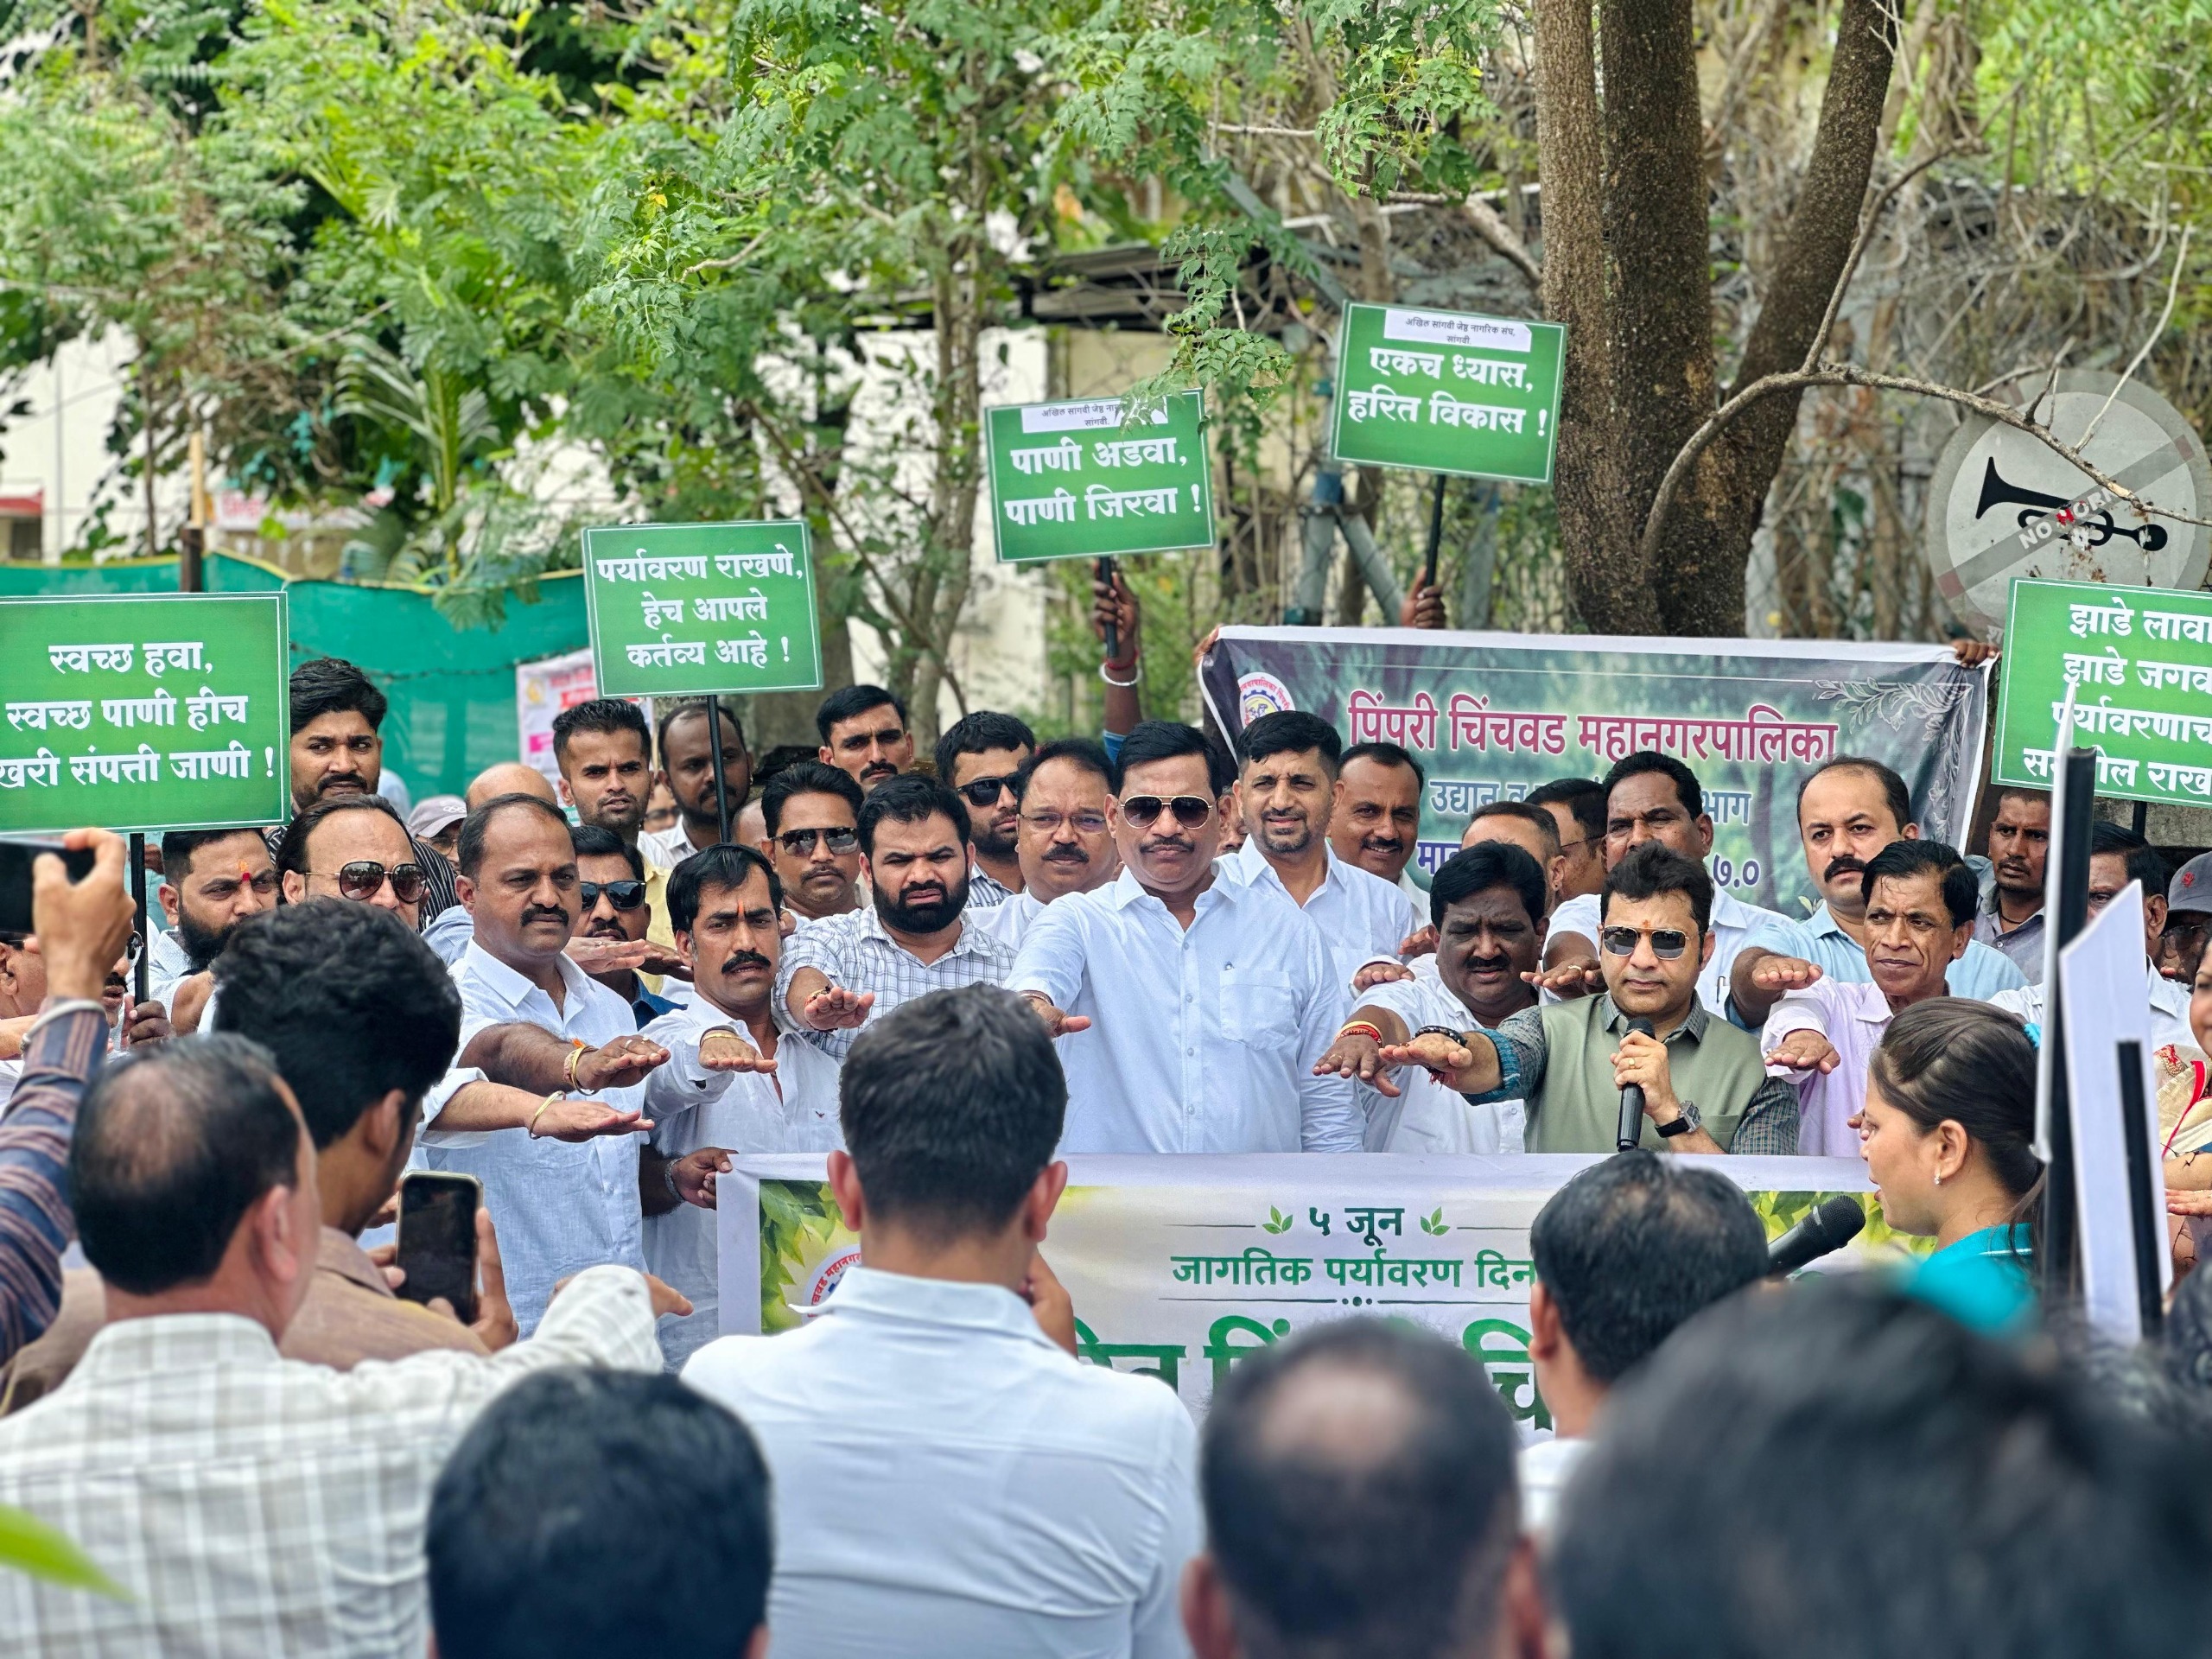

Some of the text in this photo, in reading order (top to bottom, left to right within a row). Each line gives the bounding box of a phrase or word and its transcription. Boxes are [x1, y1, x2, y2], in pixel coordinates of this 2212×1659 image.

[1370, 347, 1533, 393] एकच ध्यास,
[1348, 384, 1421, 423] हरित
[1429, 391, 1526, 434] विकास
[1010, 436, 1187, 474] पाणी अडवा,
[1004, 487, 1077, 525] पाणी
[1084, 484, 1178, 520] जिरवा
[2018, 521, 2052, 550] NO
[596, 543, 803, 583] पर्यावरण राखणे,
[641, 588, 768, 630] हेच आपले
[2070, 597, 2134, 638] झाडे
[48, 642, 213, 677] स्वच्छ हवा,
[626, 634, 706, 668] कर्तव्य
[715, 630, 767, 669] आहे
[2063, 646, 2212, 695] झाडे जगव
[5, 686, 248, 732] स्वच्छ पाणी हीच
[1348, 690, 1839, 764] पिंपरी चिंचवड महानगरपालिका
[0, 747, 60, 788] खरी
[69, 743, 160, 785] संपत्ती
[169, 740, 251, 779] जाणी
[2147, 761, 2212, 796] राख
[1430, 780, 1500, 813] उद्यान
[1700, 790, 1752, 824] भाग
[1309, 1207, 1405, 1246] ५ जून
[1171, 1248, 1535, 1290] जागतिक पर्यावरण दिन
